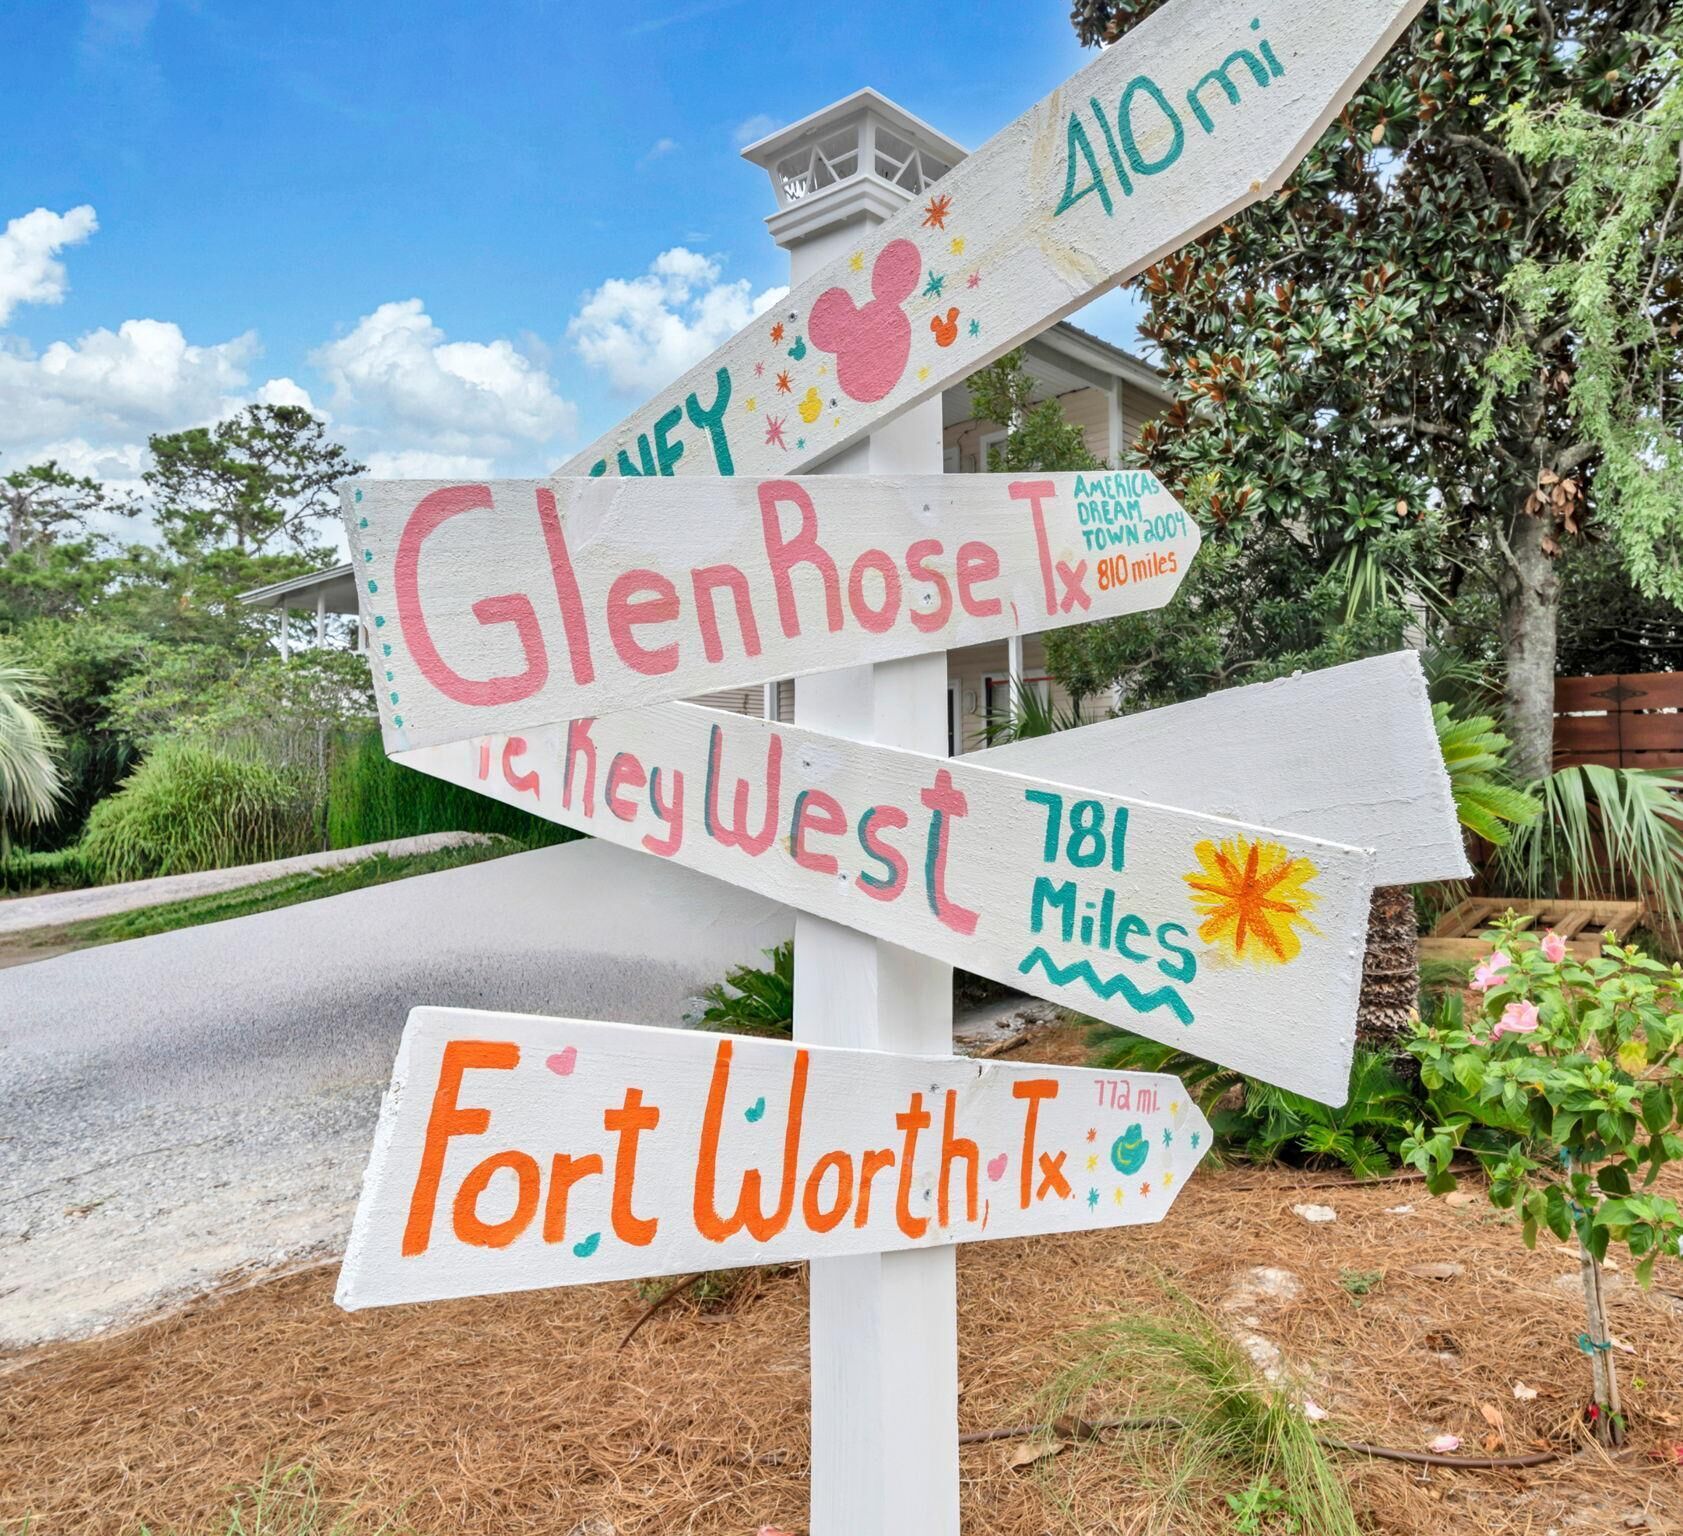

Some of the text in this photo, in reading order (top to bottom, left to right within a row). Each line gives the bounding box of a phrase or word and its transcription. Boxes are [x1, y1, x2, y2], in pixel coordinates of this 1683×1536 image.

[1053, 17, 1286, 217] 410 mi
[1077, 499, 1143, 527] DREAM
[1081, 511, 1188, 551] TOWN 2004
[394, 480, 1093, 706] Glen Rose, Tx
[1096, 550, 1179, 591] 810 miles
[561, 717, 685, 858] Key
[703, 723, 982, 937] West
[1025, 789, 1129, 872] 781
[1030, 876, 1198, 985] Miles
[1094, 1079, 1131, 1111] 772
[401, 1039, 661, 1258] Fort
[693, 1039, 990, 1244] Worth,
